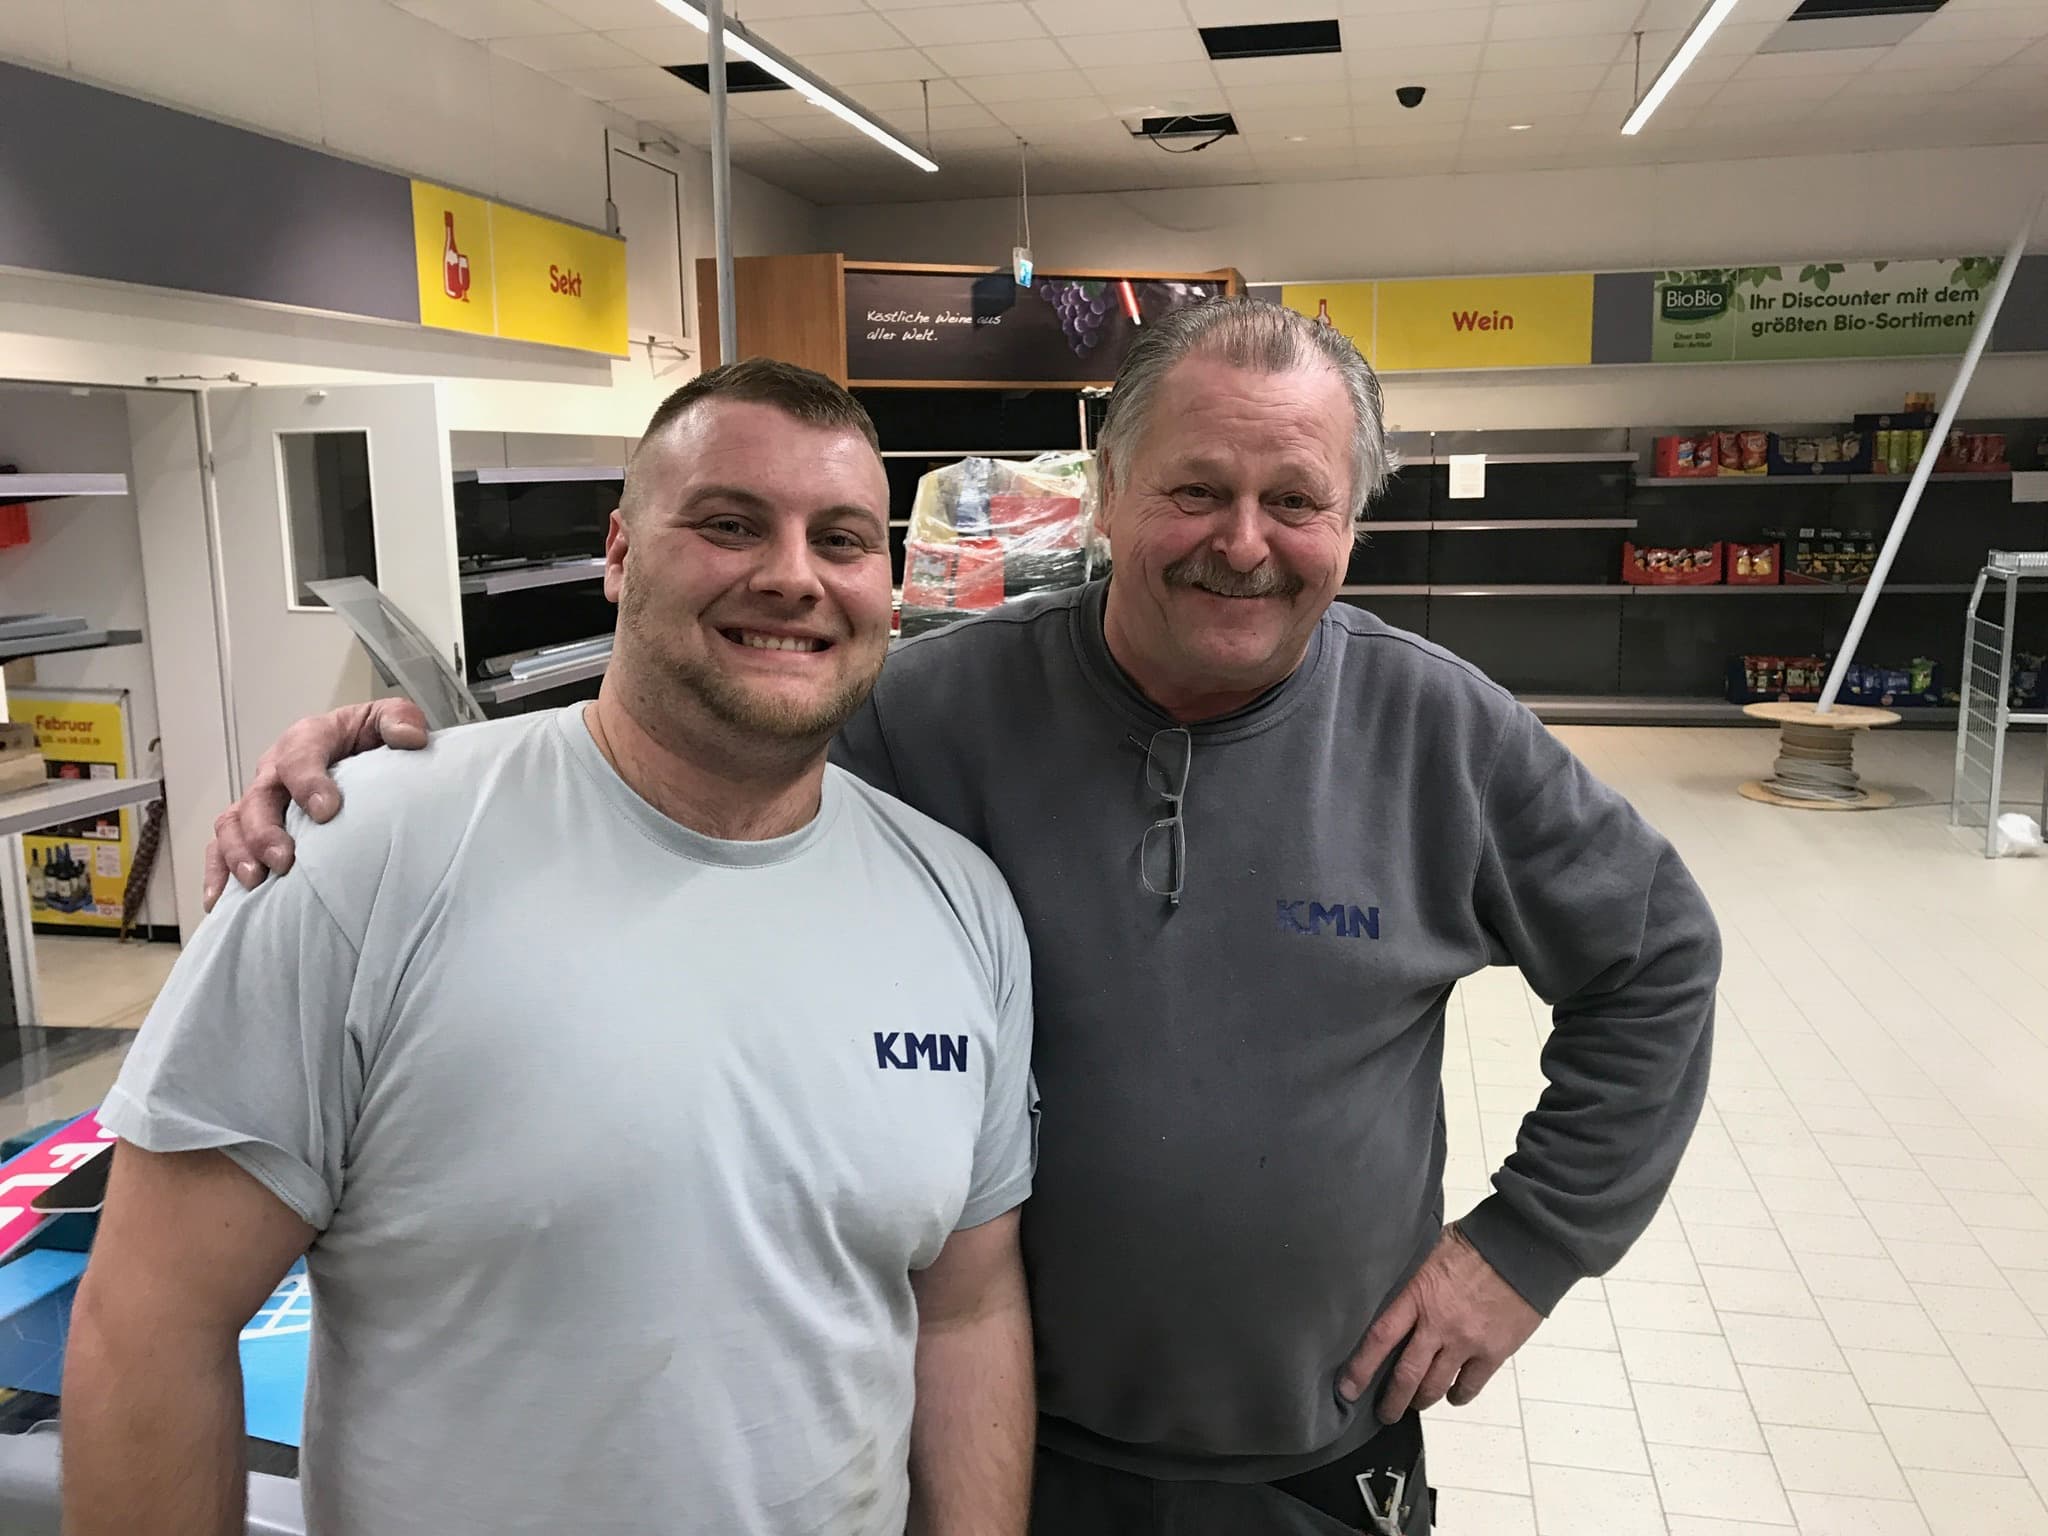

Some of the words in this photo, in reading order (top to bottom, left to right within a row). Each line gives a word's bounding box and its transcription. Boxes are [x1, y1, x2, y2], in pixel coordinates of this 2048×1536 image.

[549, 264, 582, 297] Sekt
[1666, 289, 1722, 307] BioBio
[1750, 293, 1776, 310] Ihr
[1782, 290, 1891, 309] Discounter
[1896, 287, 1928, 304] mit
[1934, 286, 1979, 302] dem
[935, 310, 973, 324] Weine
[976, 315, 1002, 325] aus
[1452, 310, 1513, 332] Wein
[1751, 316, 1827, 338] größten
[1833, 311, 1975, 331] Bio-Sortiment
[866, 327, 897, 340] aller
[901, 327, 938, 341] Welt.
[35, 714, 94, 732] Februar
[1276, 899, 1380, 940] KMN
[873, 1031, 968, 1072] KMN
